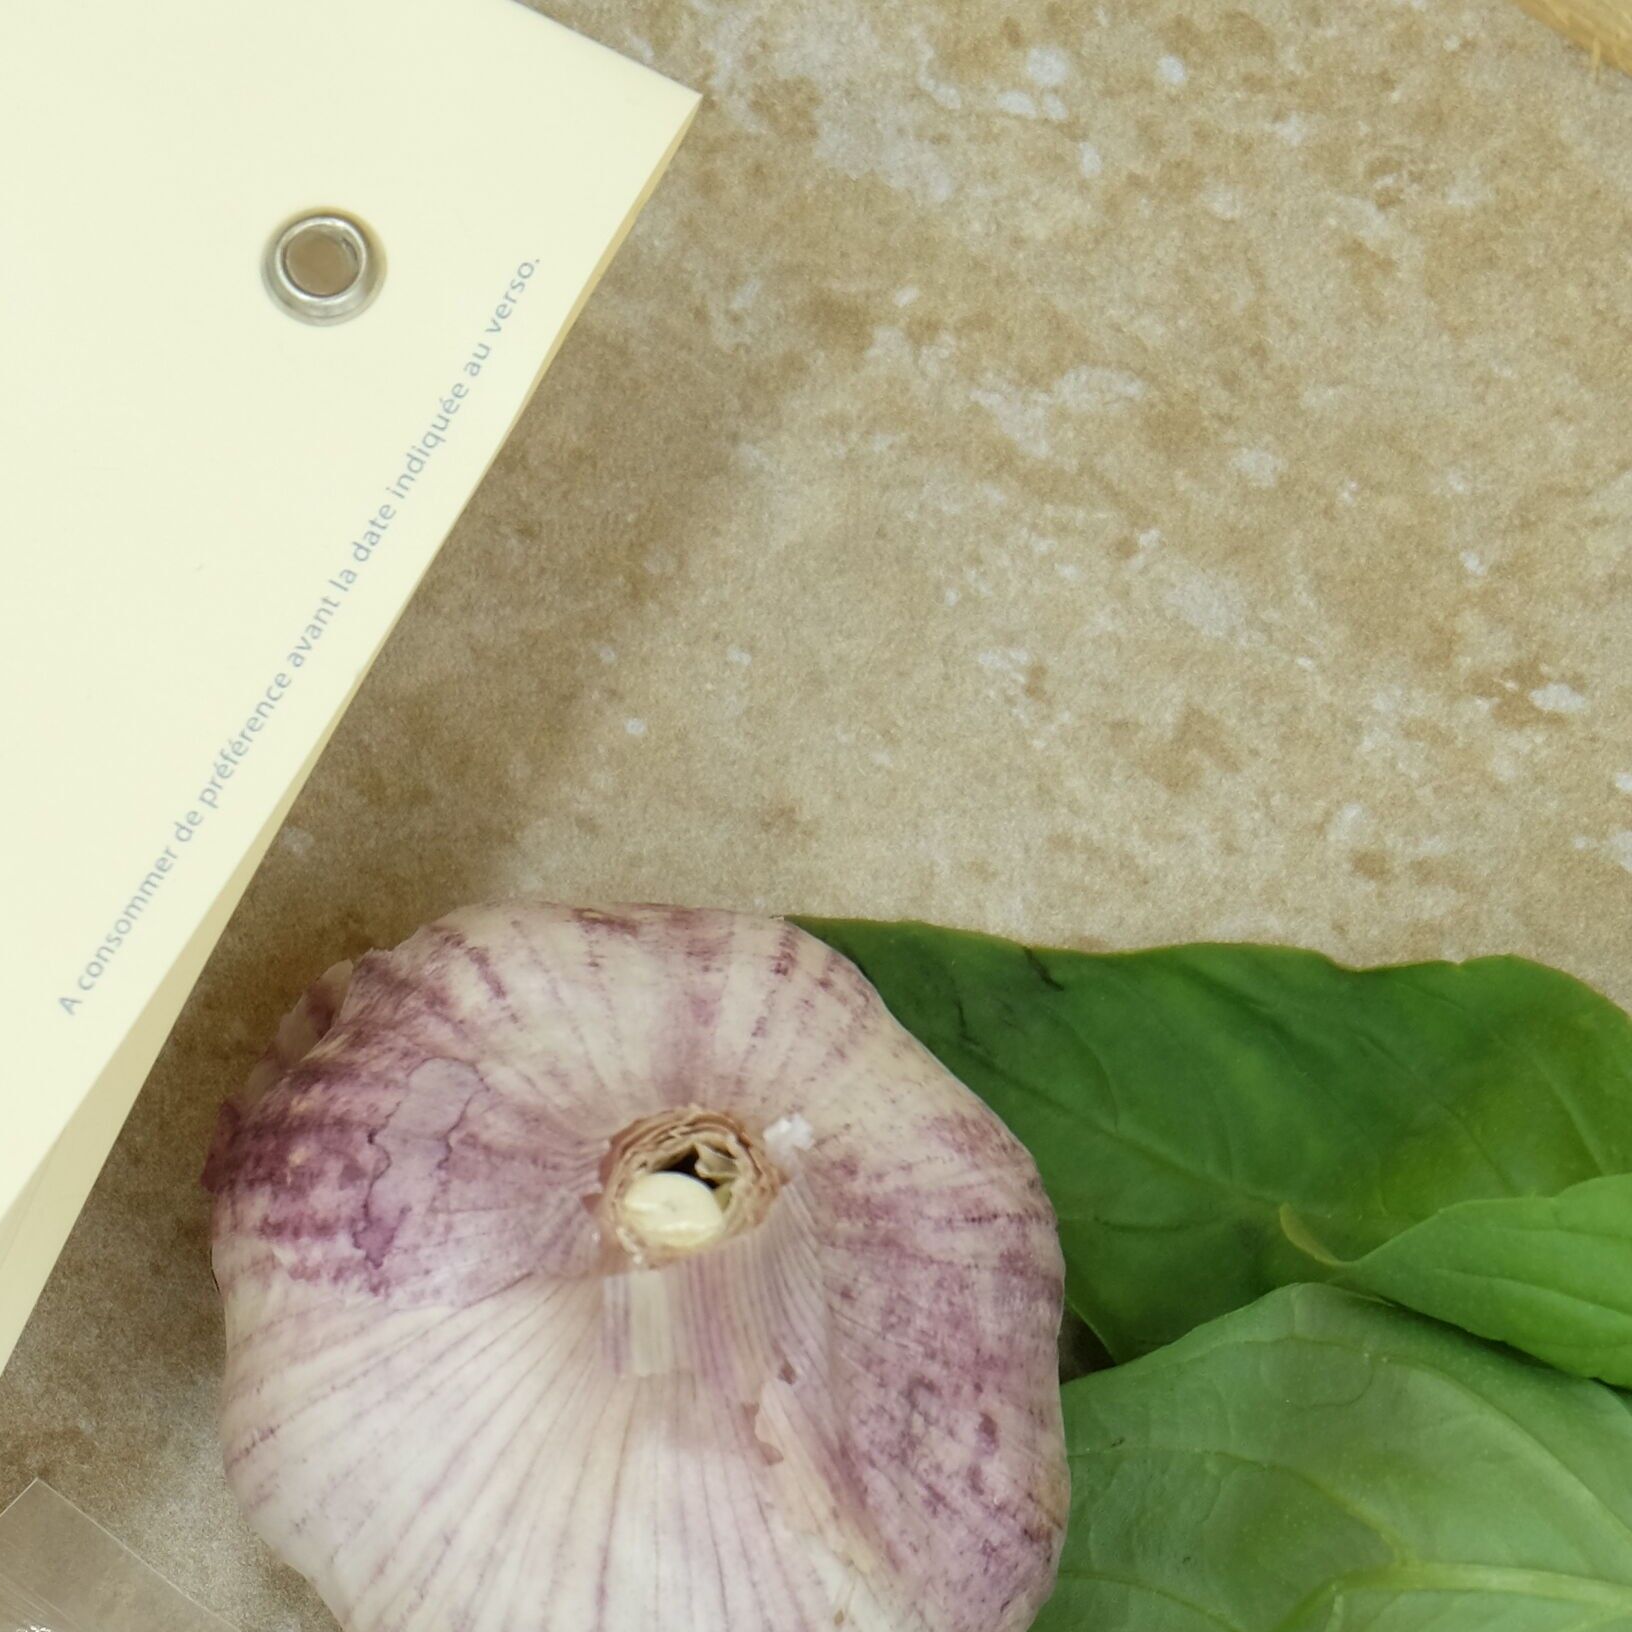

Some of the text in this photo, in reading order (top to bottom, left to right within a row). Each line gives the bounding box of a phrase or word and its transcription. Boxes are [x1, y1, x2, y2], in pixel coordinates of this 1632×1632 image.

[56, 258, 541, 1017] A consommer de préférence avant la date indiquée au verso.
